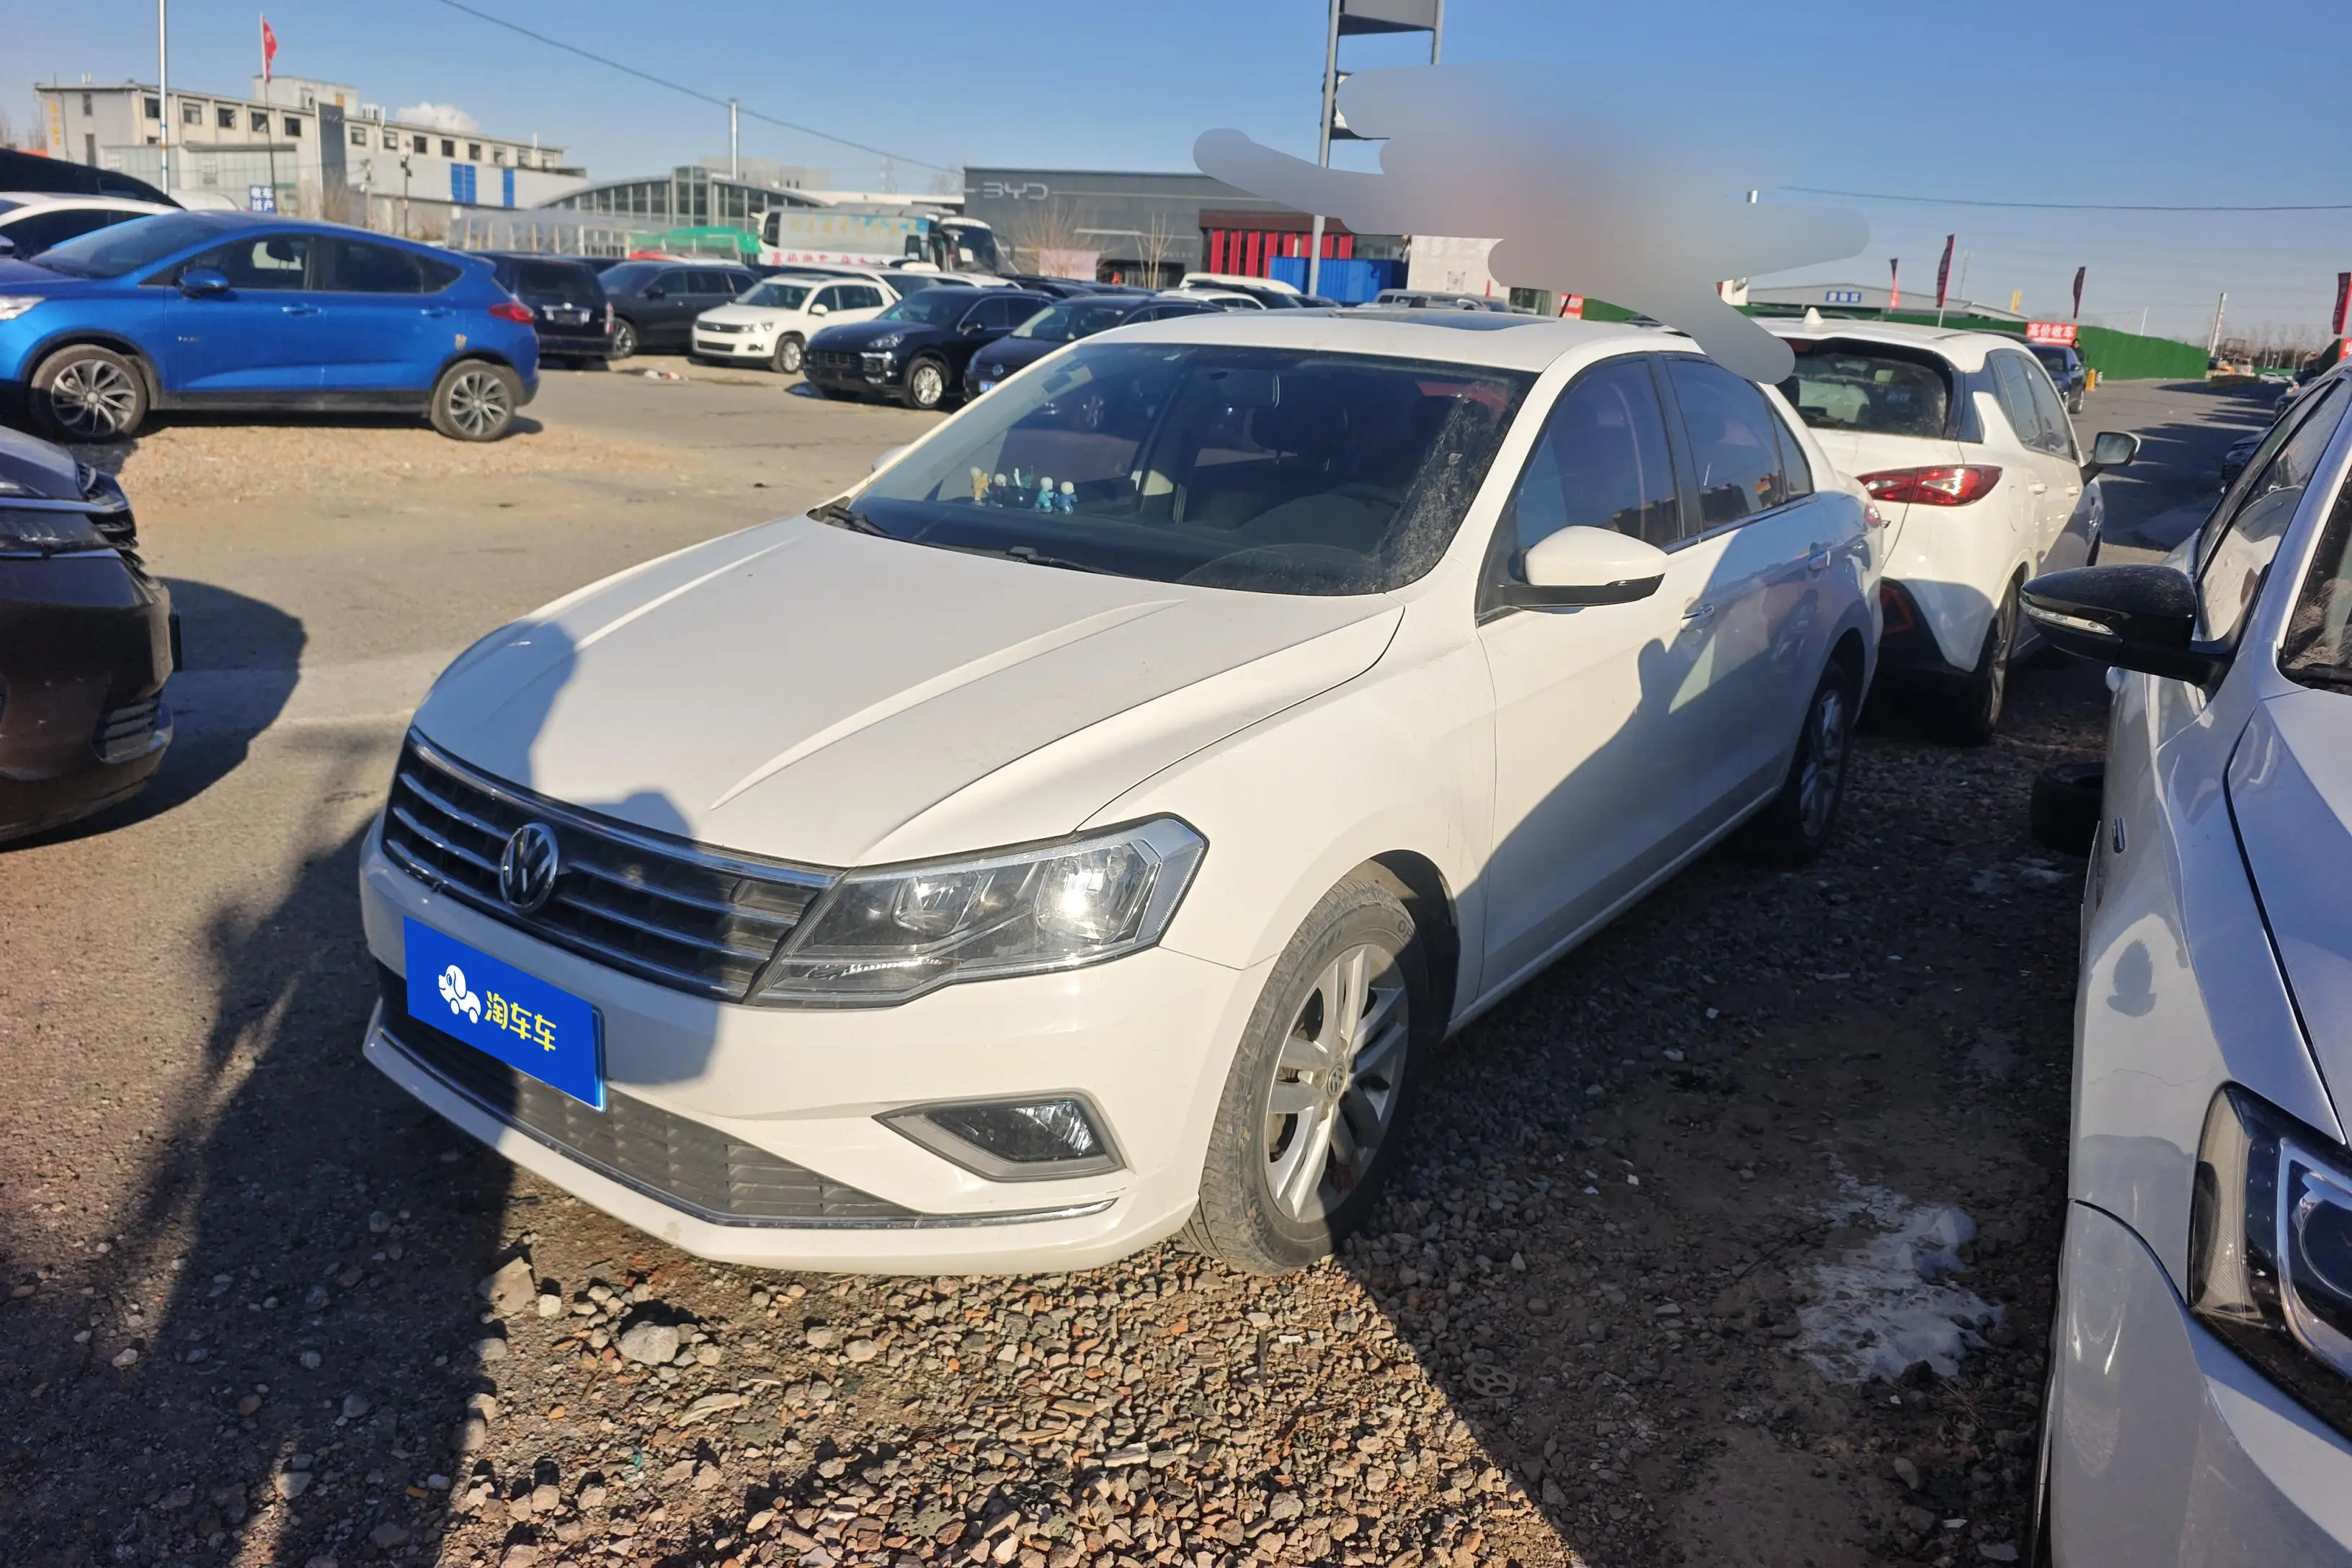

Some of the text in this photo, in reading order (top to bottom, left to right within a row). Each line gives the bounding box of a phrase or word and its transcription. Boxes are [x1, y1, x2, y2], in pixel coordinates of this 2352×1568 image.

[983, 182, 1049, 200] BYD
[2028, 323, 2076, 339] 高价收车
